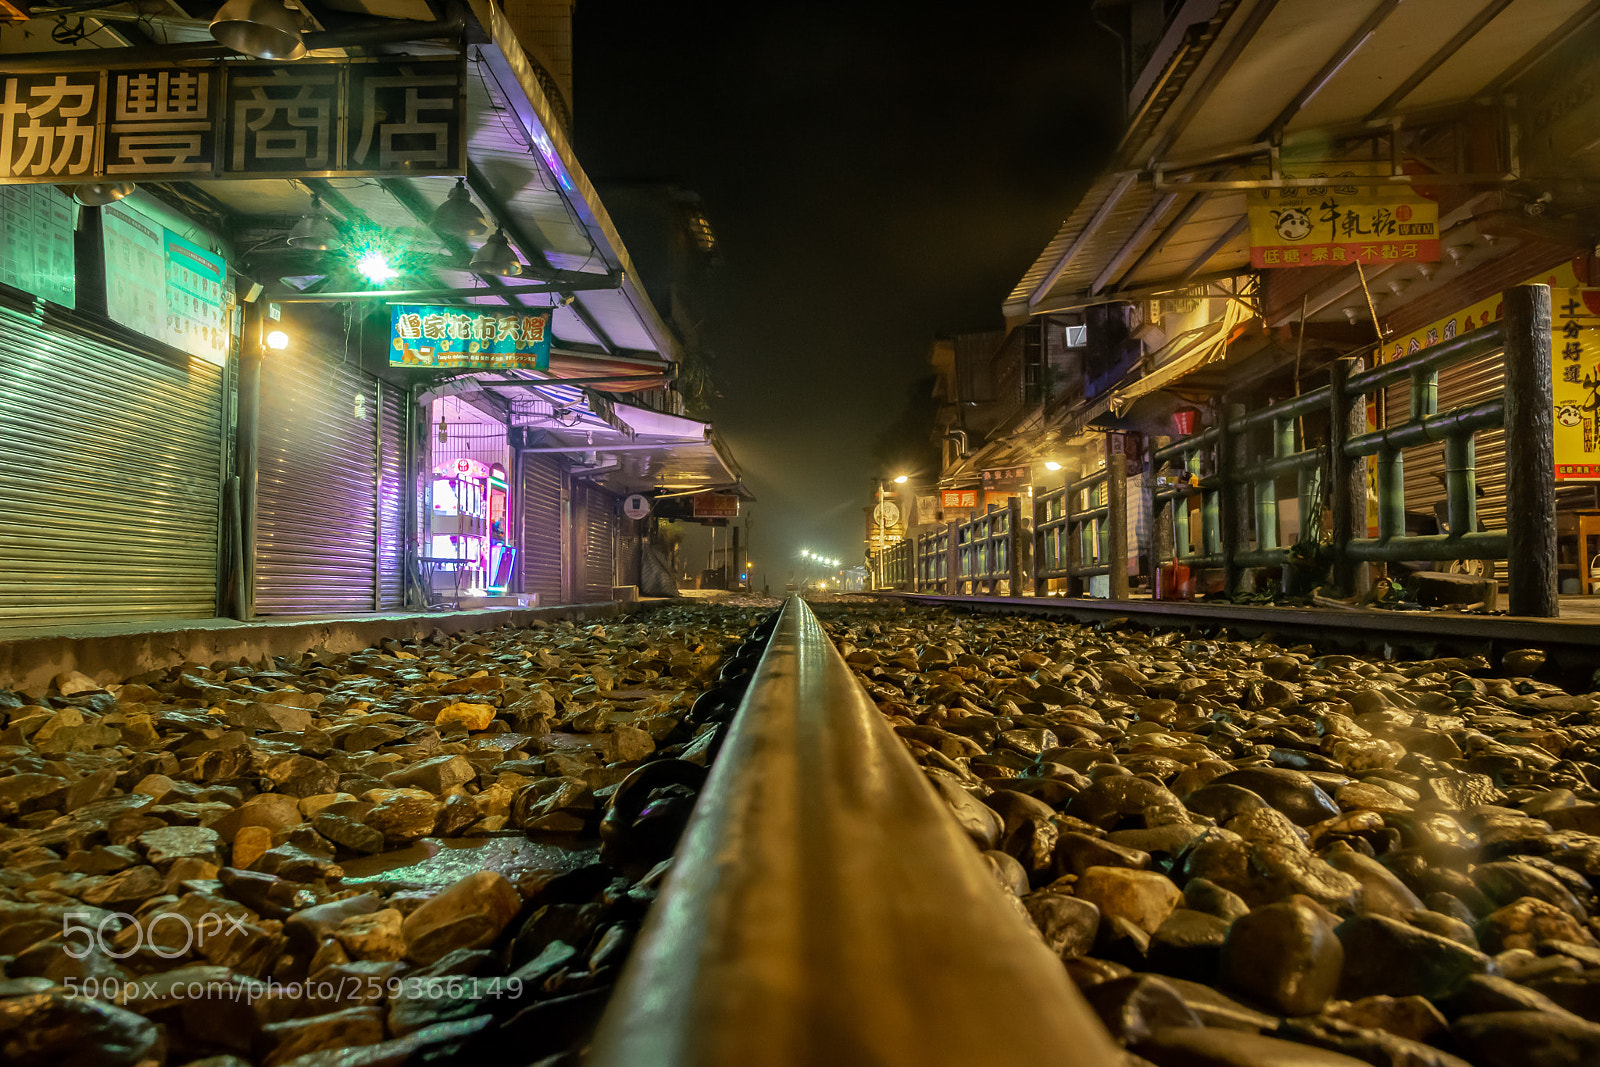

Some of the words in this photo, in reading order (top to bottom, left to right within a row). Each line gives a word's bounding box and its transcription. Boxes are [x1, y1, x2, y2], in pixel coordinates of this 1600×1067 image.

[0, 69, 459, 175] 協豐商店
[1319, 197, 1396, 242] 牛軋糖
[399, 314, 546, 341] 曾家花布天燈
[1561, 298, 1584, 384] 十分好運
[944, 492, 975, 507] 藥房
